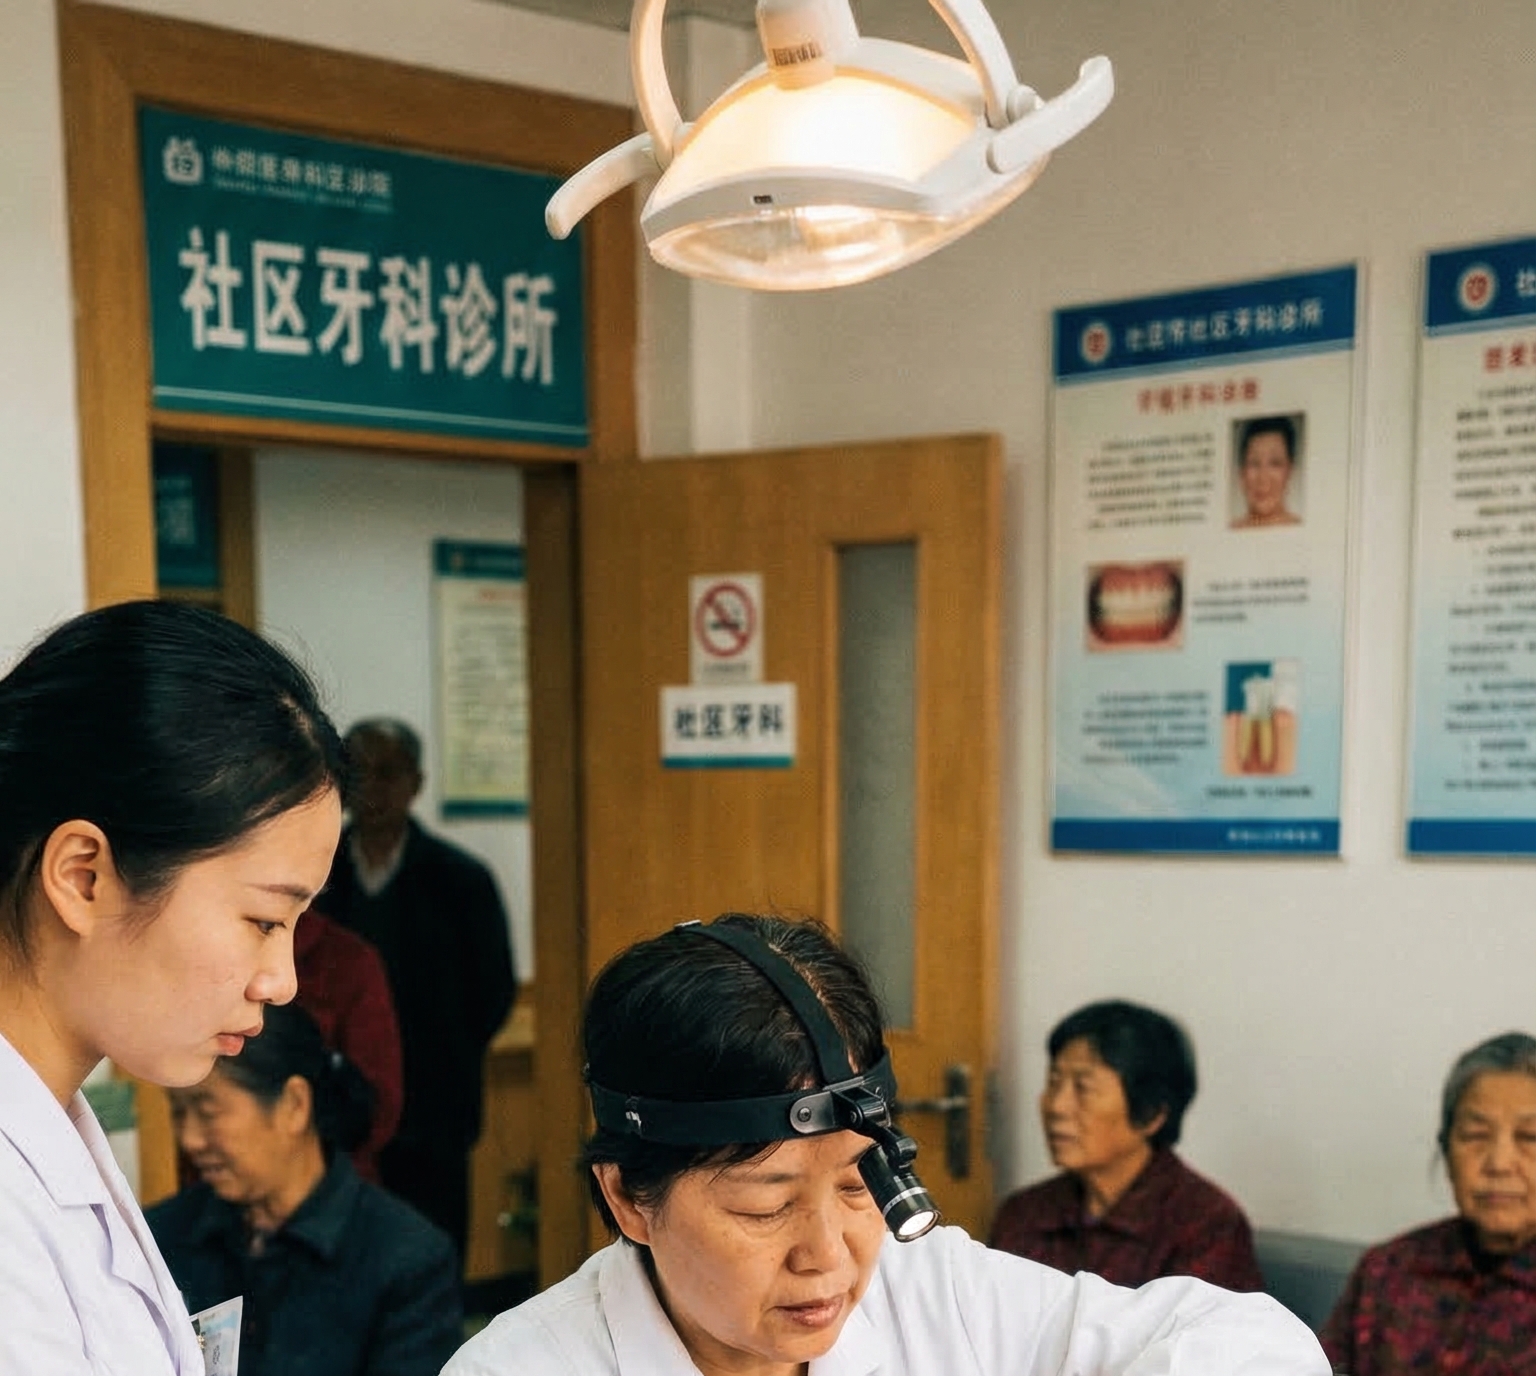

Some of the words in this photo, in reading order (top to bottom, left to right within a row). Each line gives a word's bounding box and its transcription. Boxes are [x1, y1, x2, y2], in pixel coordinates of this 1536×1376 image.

[178, 226, 558, 386] 社区牙科诊所
